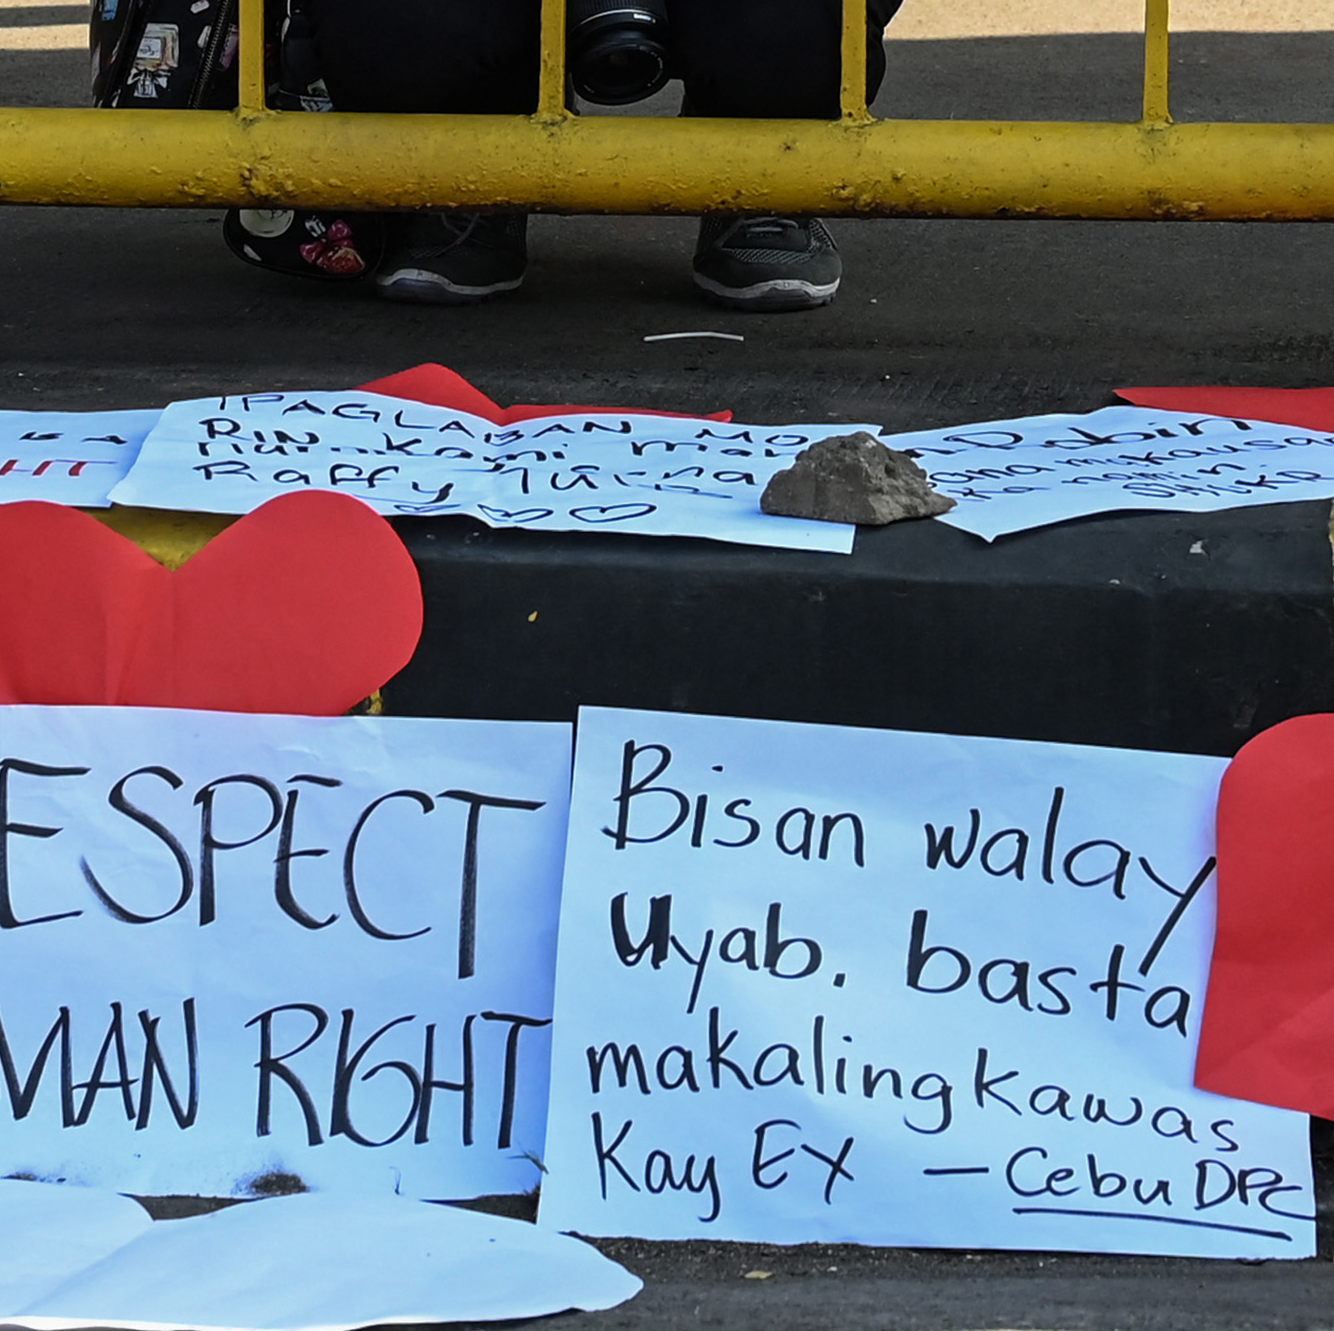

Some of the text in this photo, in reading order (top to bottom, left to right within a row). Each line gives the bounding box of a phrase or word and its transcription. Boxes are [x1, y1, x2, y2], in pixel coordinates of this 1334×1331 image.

[218, 395, 811, 448] IPAGLABAN MO
[601, 739, 1218, 975] Bisan walay
[905, 909, 1190, 1039] basta
[244, 1002, 554, 1151] RIGHT
